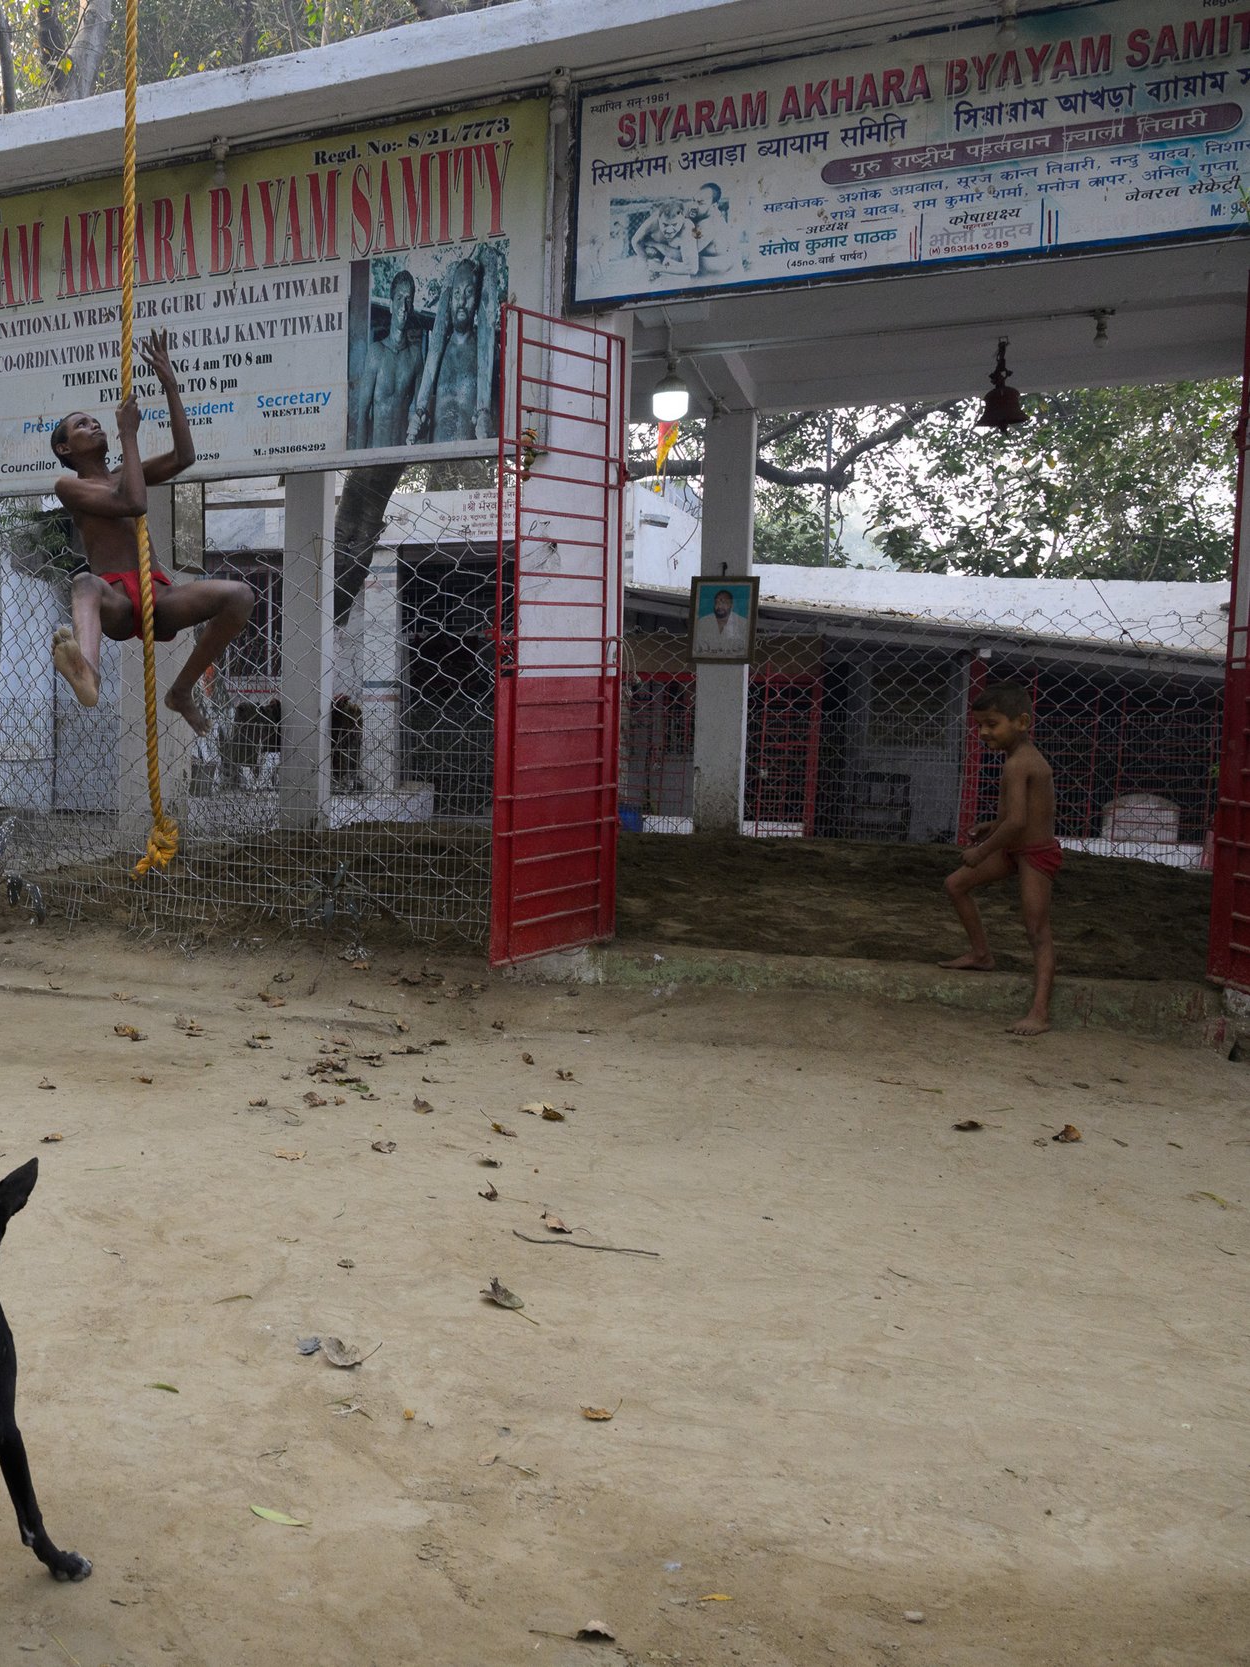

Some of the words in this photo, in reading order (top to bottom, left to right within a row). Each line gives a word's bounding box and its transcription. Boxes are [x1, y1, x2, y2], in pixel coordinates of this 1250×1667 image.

[617, 91, 769, 148] SIYARAM
[778, 64, 932, 123] AKHARA
[944, 34, 1112, 96] BYAYAM
[1125, 9, 1250, 68] SAMIT
[590, 100, 622, 114] स्थापित
[314, 145, 361, 166] Regd.
[591, 156, 668, 185] सियाराम
[678, 143, 747, 171] अखाड़ा
[757, 130, 829, 157] व्यायाम
[840, 112, 907, 148] समिति
[851, 159, 882, 178] गुरु
[892, 144, 956, 169] राष्ट्रीय
[966, 133, 1052, 162] पहलवान
[1137, 110, 1208, 135] तिवारी
[830, 206, 857, 221] राधे
[913, 198, 938, 210] राम
[945, 191, 985, 209] कुमार
[1037, 178, 1081, 194] मनोज
[1141, 165, 1190, 182] अनिल
[837, 187, 883, 204] अशोक
[957, 174, 992, 189] सूरज
[1000, 166, 1038, 181] कान्त
[1125, 186, 1181, 202] जेनरल
[56, 193, 201, 299] AKHARA
[208, 169, 342, 277] BAYAM
[350, 140, 514, 258] SAMITY
[759, 237, 800, 256] संतोष
[805, 234, 848, 255] कुमार
[854, 229, 898, 244] पाठक
[929, 227, 975, 247] भोला
[983, 222, 1035, 241] यादव
[0, 313, 71, 340] NATIONAL
[73, 300, 158, 328] WRESTER
[161, 292, 206, 315] GURU
[212, 283, 269, 308] JWALA
[272, 275, 340, 296] TIWARI
[182, 325, 231, 348] SURAJ
[235, 319, 278, 343] KANT
[280, 312, 344, 337] TIWARI
[62, 367, 118, 388] TIMEING
[192, 359, 200, 372] 4
[203, 360, 220, 370] am
[223, 352, 242, 369] TO
[245, 351, 253, 366] 8
[255, 354, 273, 365] am
[100, 382, 156, 403] EVEING
[188, 377, 207, 392] TO
[210, 376, 217, 390] 8
[220, 377, 238, 394] pm
[257, 391, 332, 409] Secretary
[140, 401, 235, 421] Vice-esident
[262, 405, 321, 419] WRESTLER
[269, 443, 326, 456] 9831668292
[0, 460, 57, 474] Councillor
